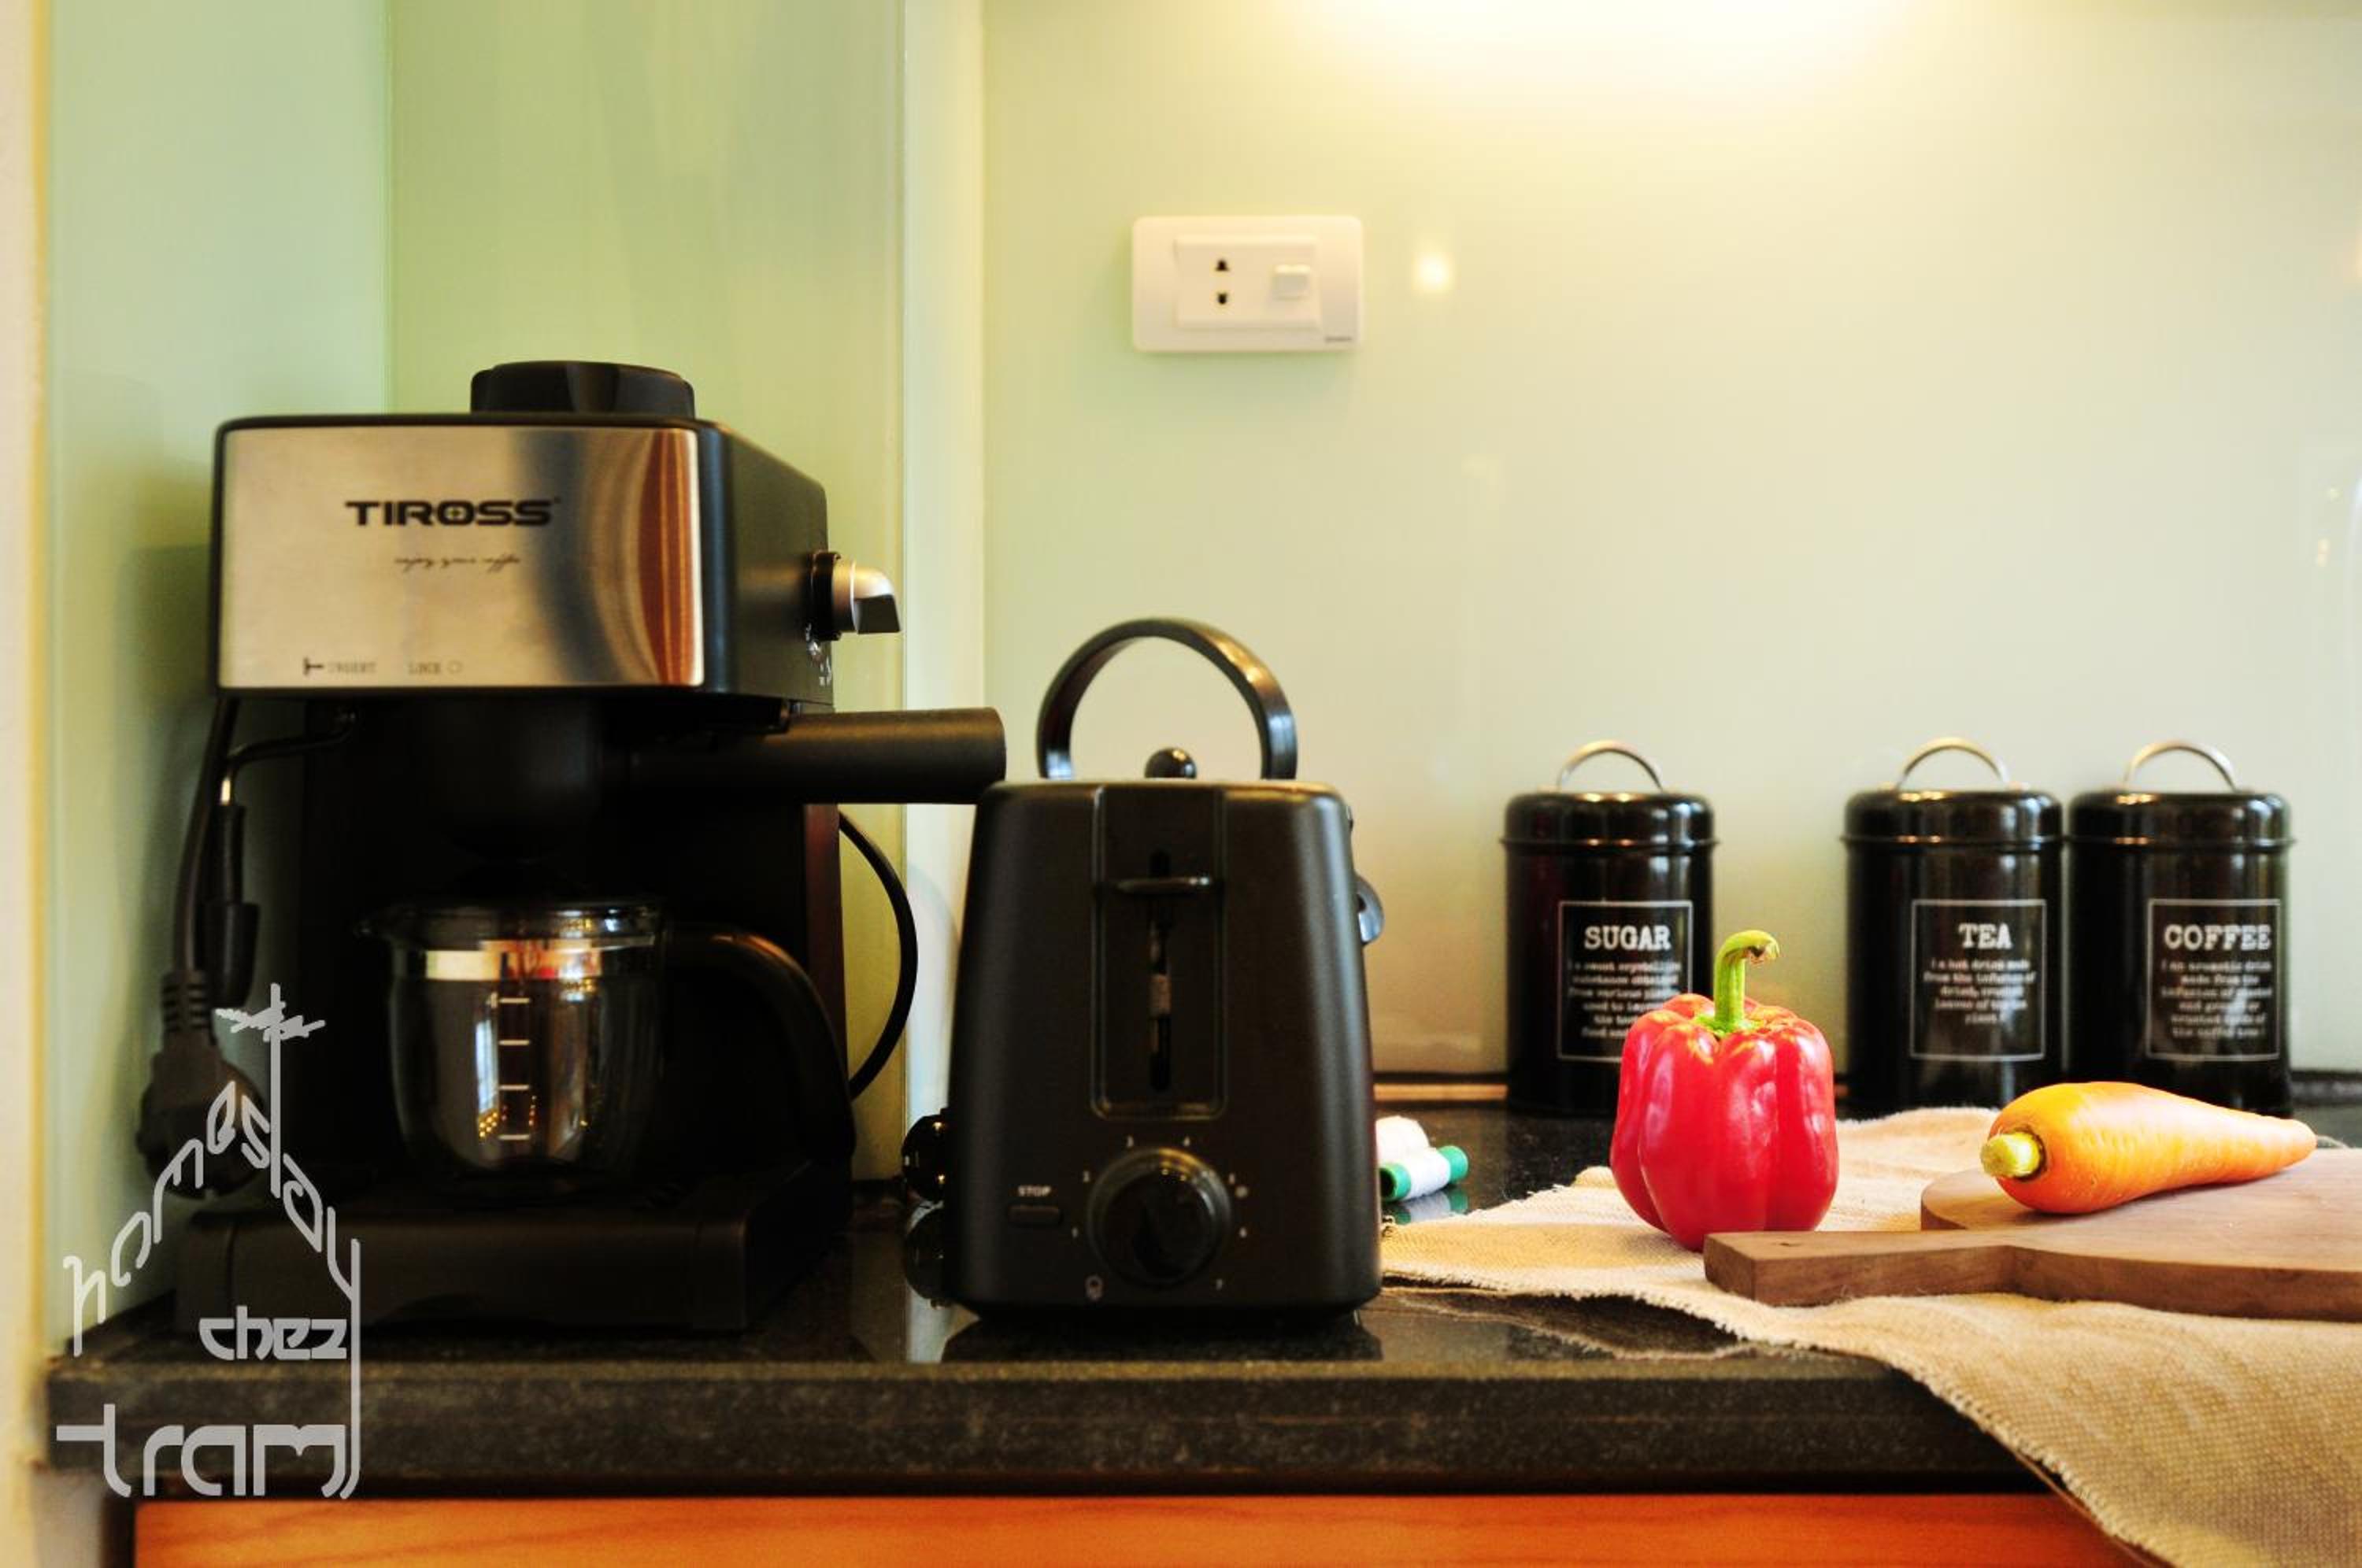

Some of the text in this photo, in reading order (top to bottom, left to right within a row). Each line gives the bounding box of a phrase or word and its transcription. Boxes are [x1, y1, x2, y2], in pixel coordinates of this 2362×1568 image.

[346, 500, 553, 527] TIROSS
[1584, 925, 1672, 950] SUGAR
[1958, 922, 2013, 949] TEA
[2164, 924, 2271, 950] COFFEE
[1018, 1185, 1051, 1196] STOP
